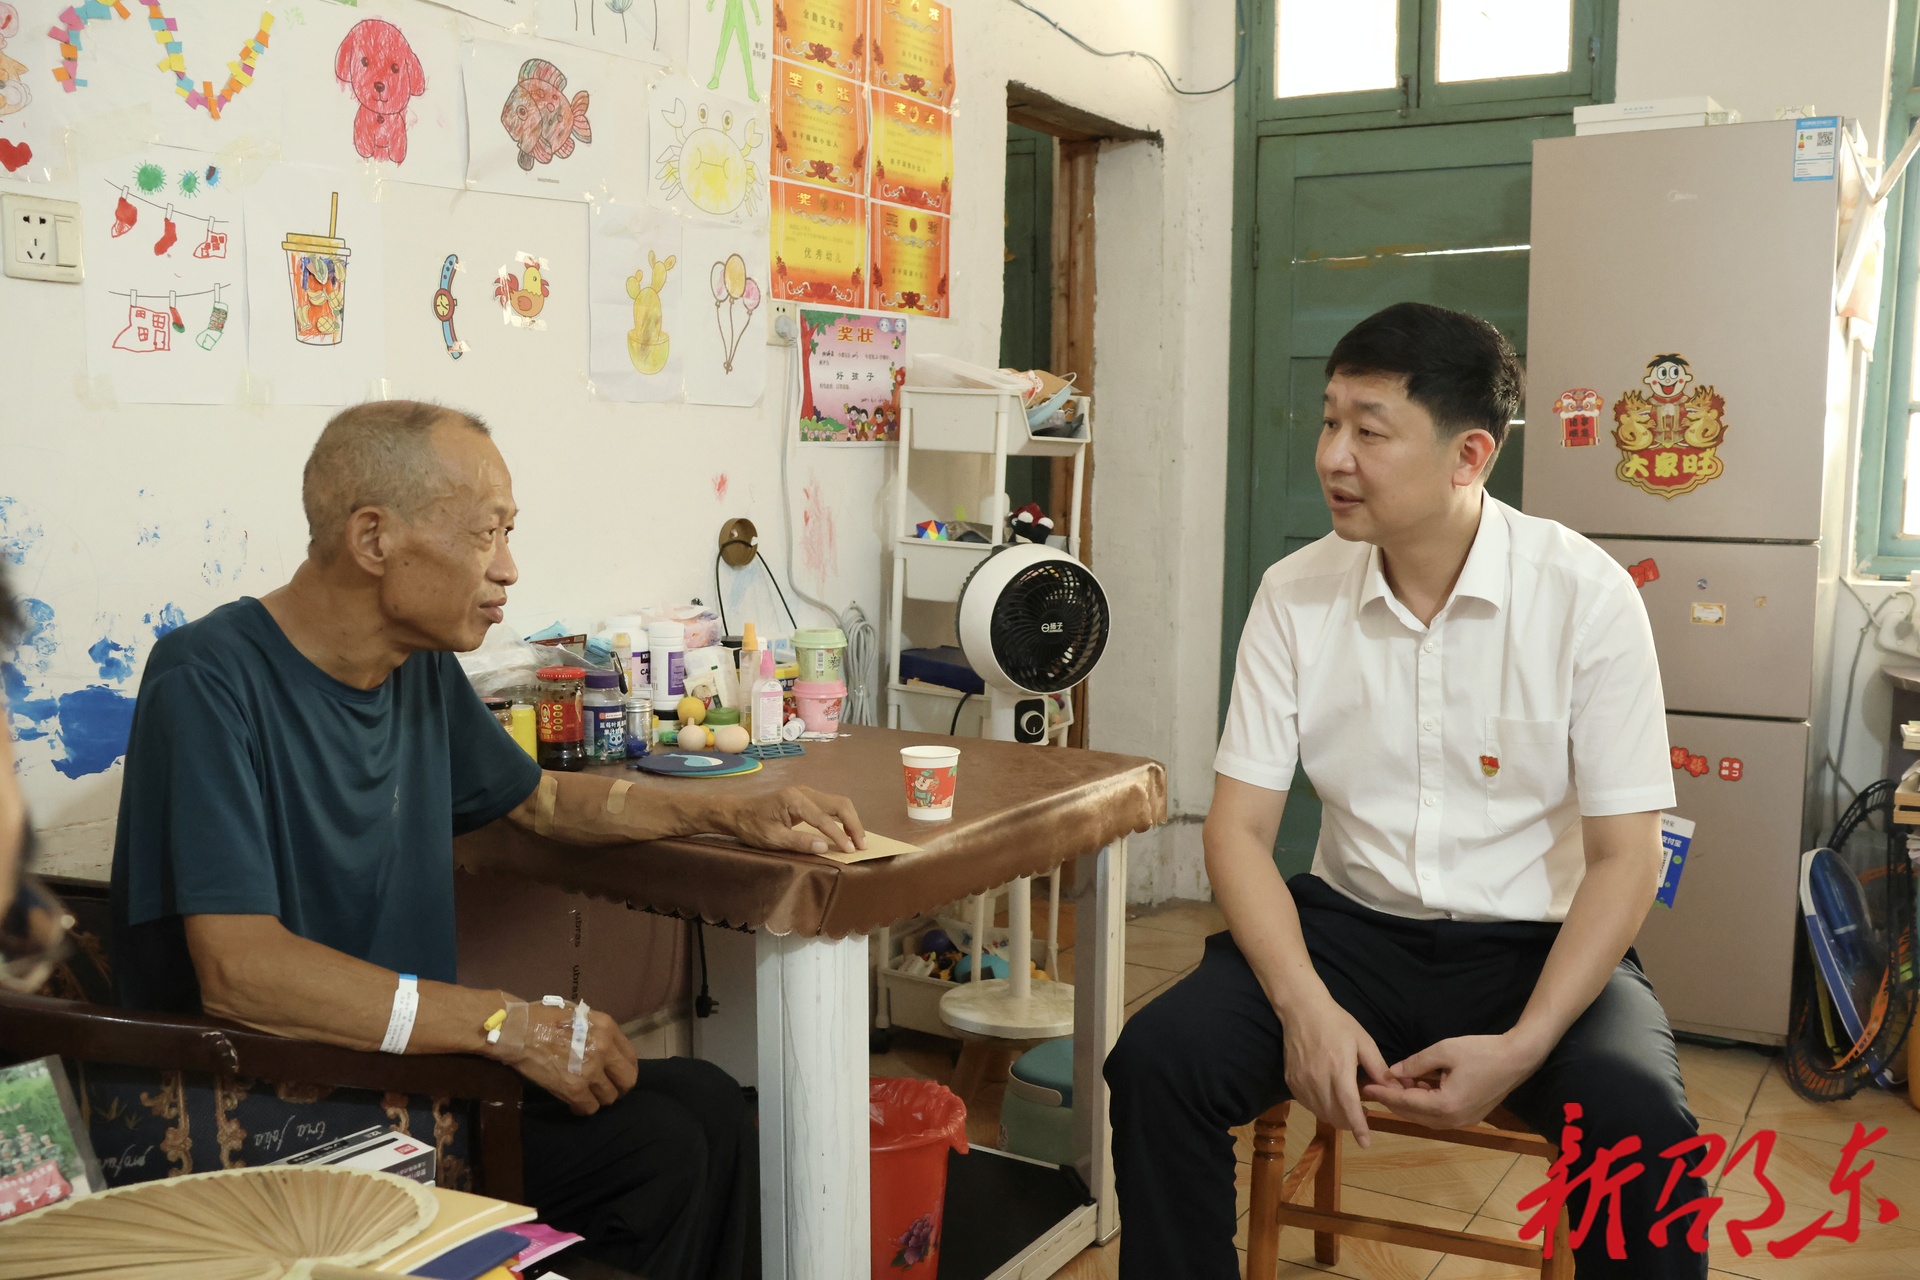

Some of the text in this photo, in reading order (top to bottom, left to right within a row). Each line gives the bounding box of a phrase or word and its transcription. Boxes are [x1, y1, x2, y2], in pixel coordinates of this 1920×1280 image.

[804, 246, 842, 263] 优秀幼儿
[837, 325, 874, 343] 奖状
[836, 371, 875, 382] 好孩子
[1625, 448, 1717, 478] 大家旺
[571, 964, 580, 1000] ubras
